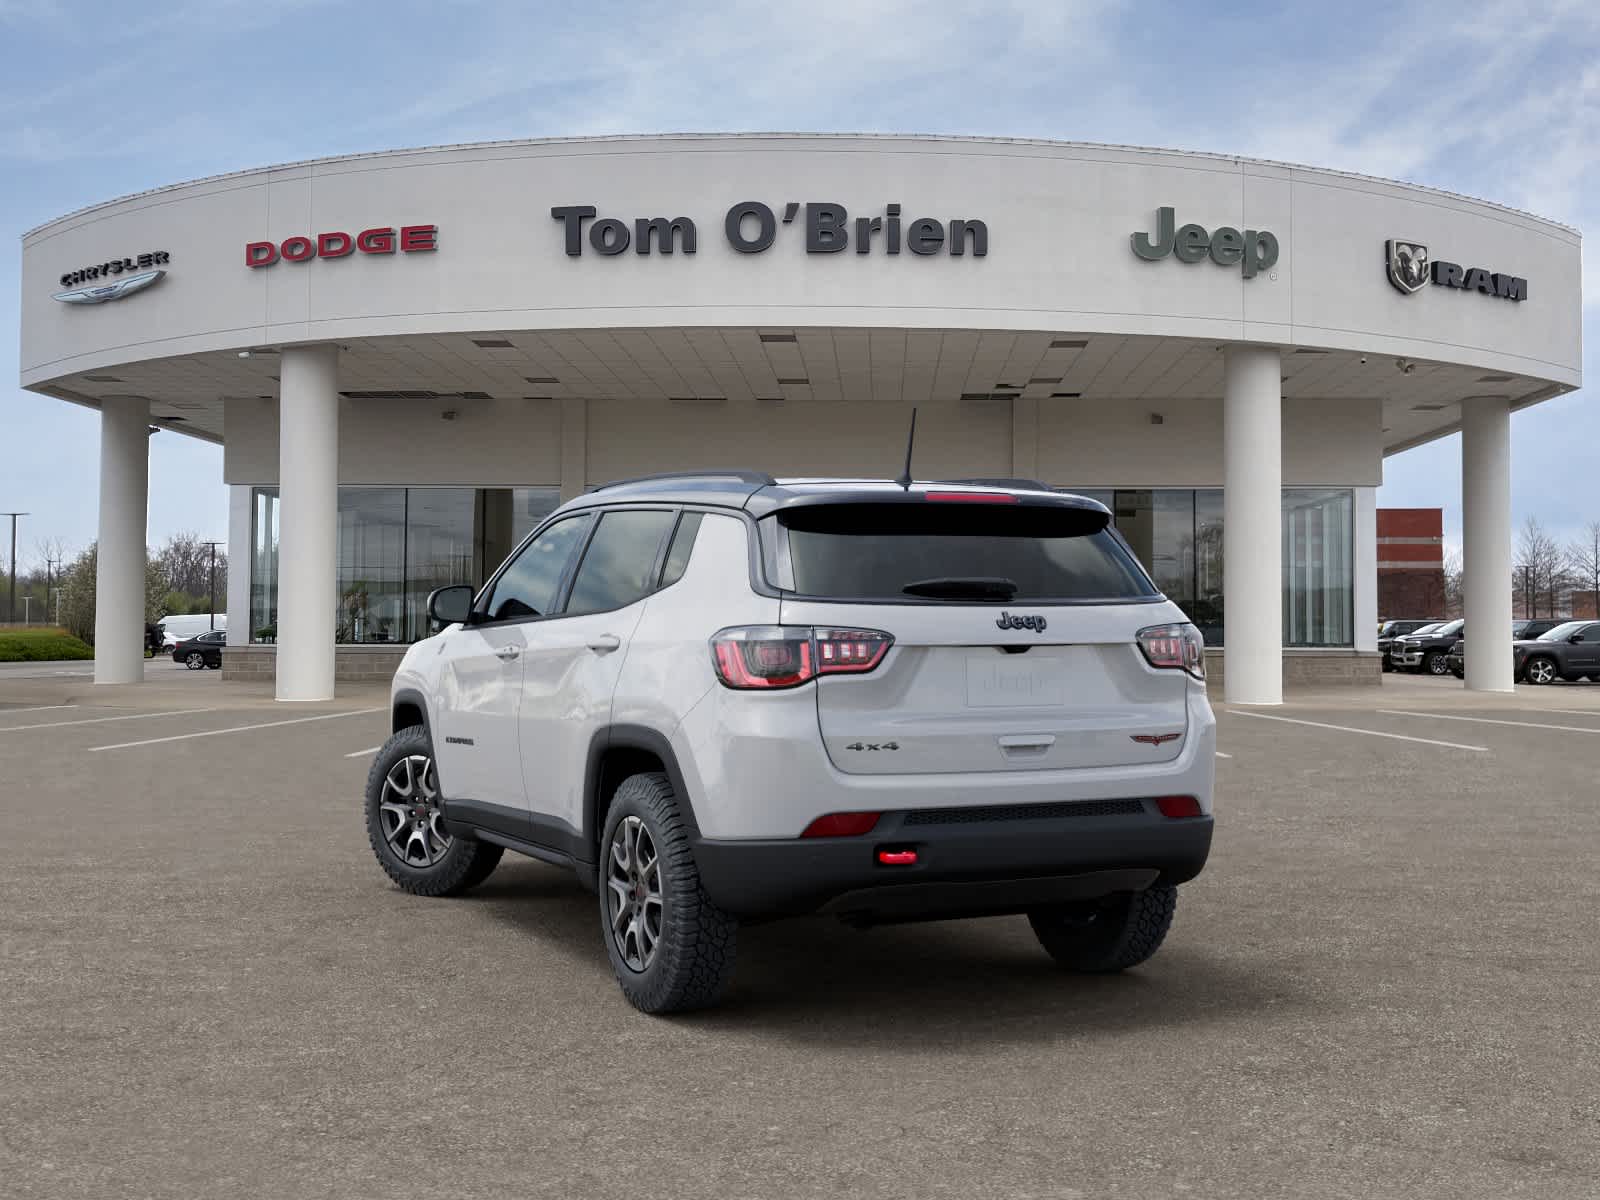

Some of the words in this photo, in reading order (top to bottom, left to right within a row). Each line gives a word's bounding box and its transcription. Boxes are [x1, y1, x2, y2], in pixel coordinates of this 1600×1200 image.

[246, 225, 437, 267] DODGE
[551, 205, 697, 256] Tom
[725, 201, 988, 256] O'Brien
[1131, 206, 1279, 280] Jeep
[60, 250, 170, 287] CHRYSLER
[1431, 260, 1528, 301] RAM
[996, 611, 1047, 634] Jeep
